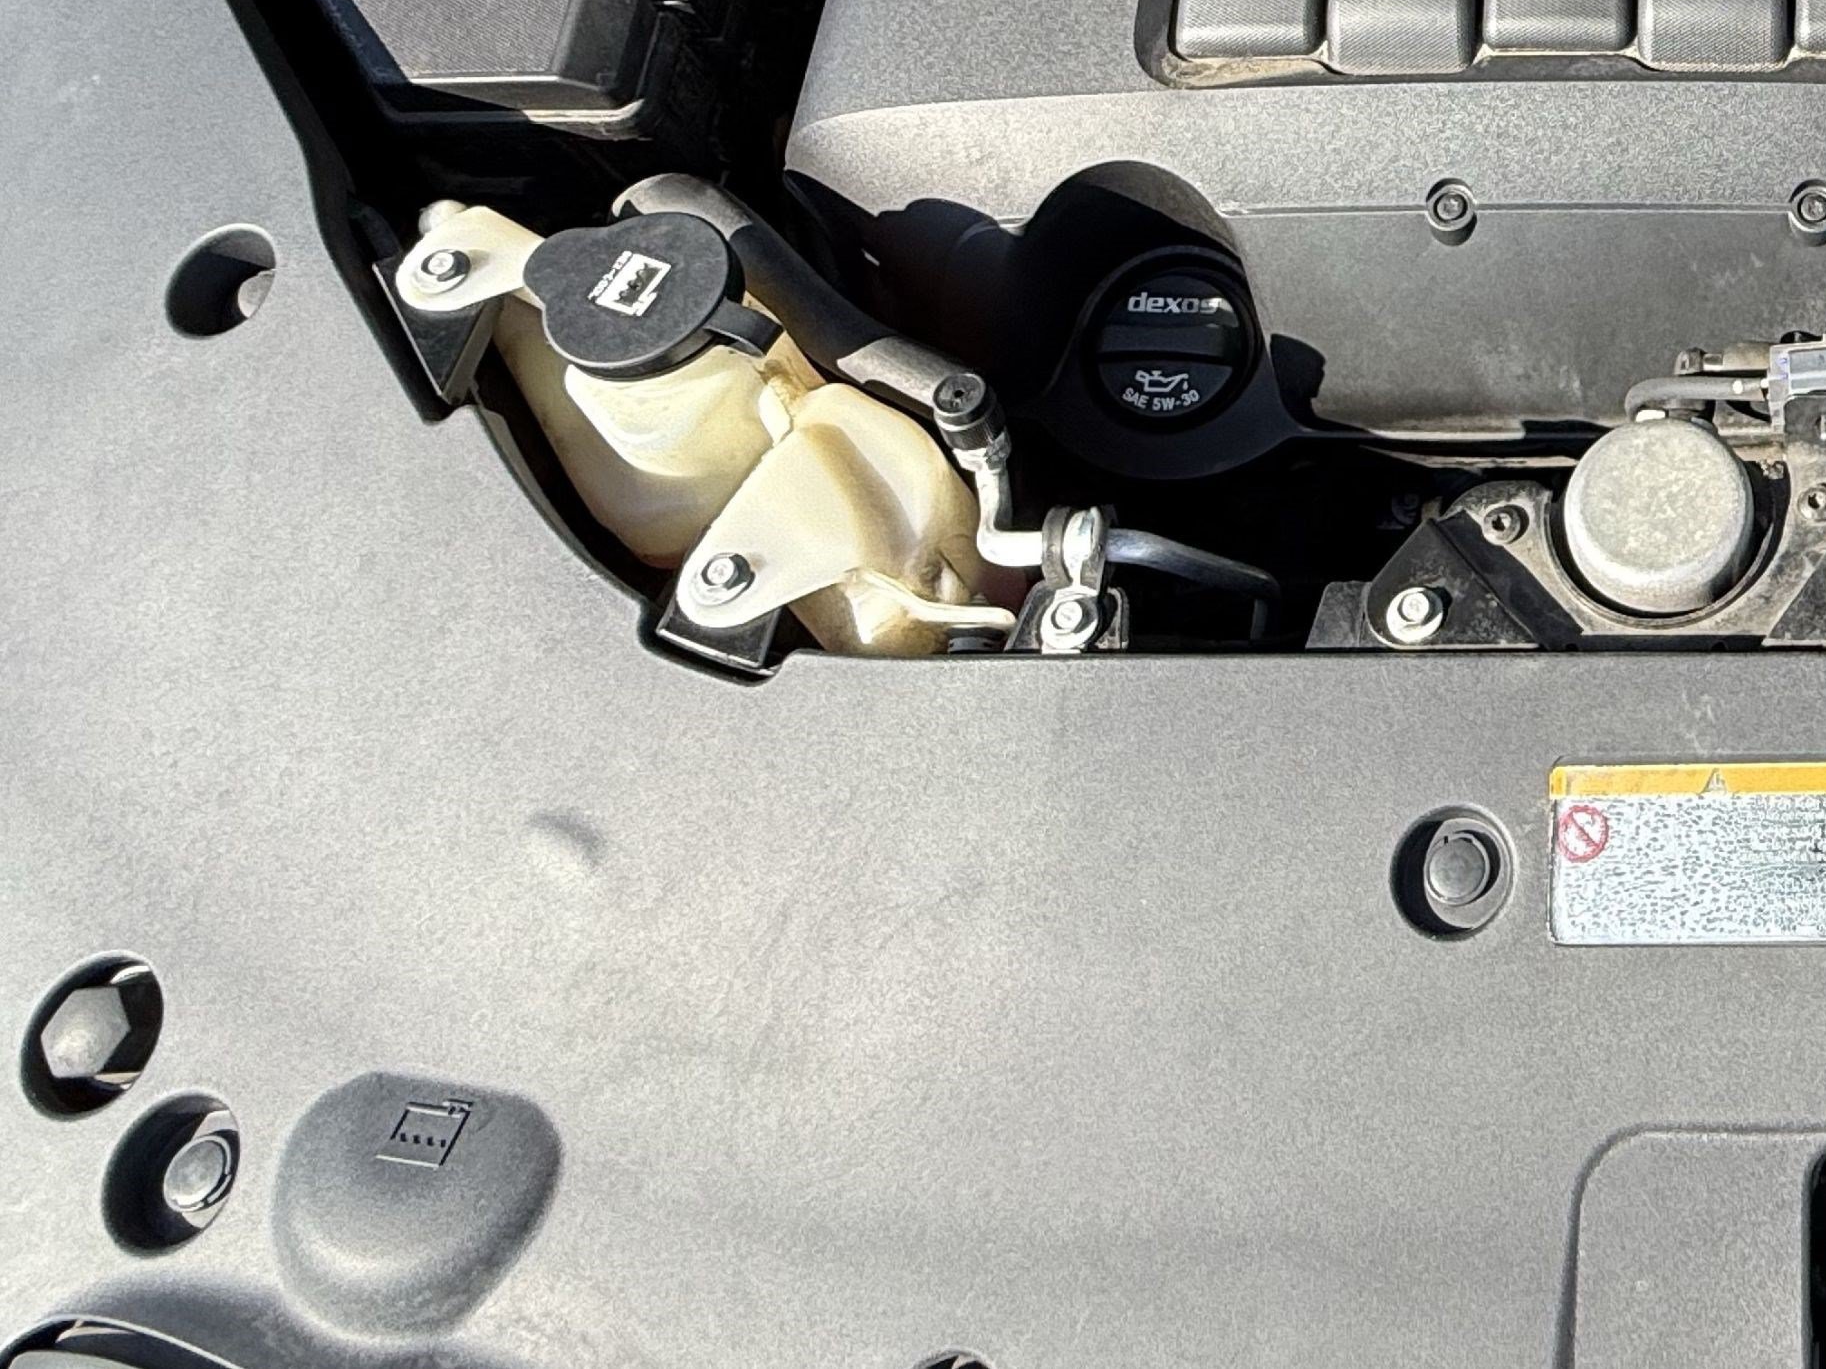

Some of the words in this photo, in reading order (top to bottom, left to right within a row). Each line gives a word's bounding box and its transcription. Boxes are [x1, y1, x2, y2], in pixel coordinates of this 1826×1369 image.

[1127, 291, 1223, 314] dexos
[1122, 387, 1150, 410] SAE
[1152, 389, 1200, 412] 5W-30
